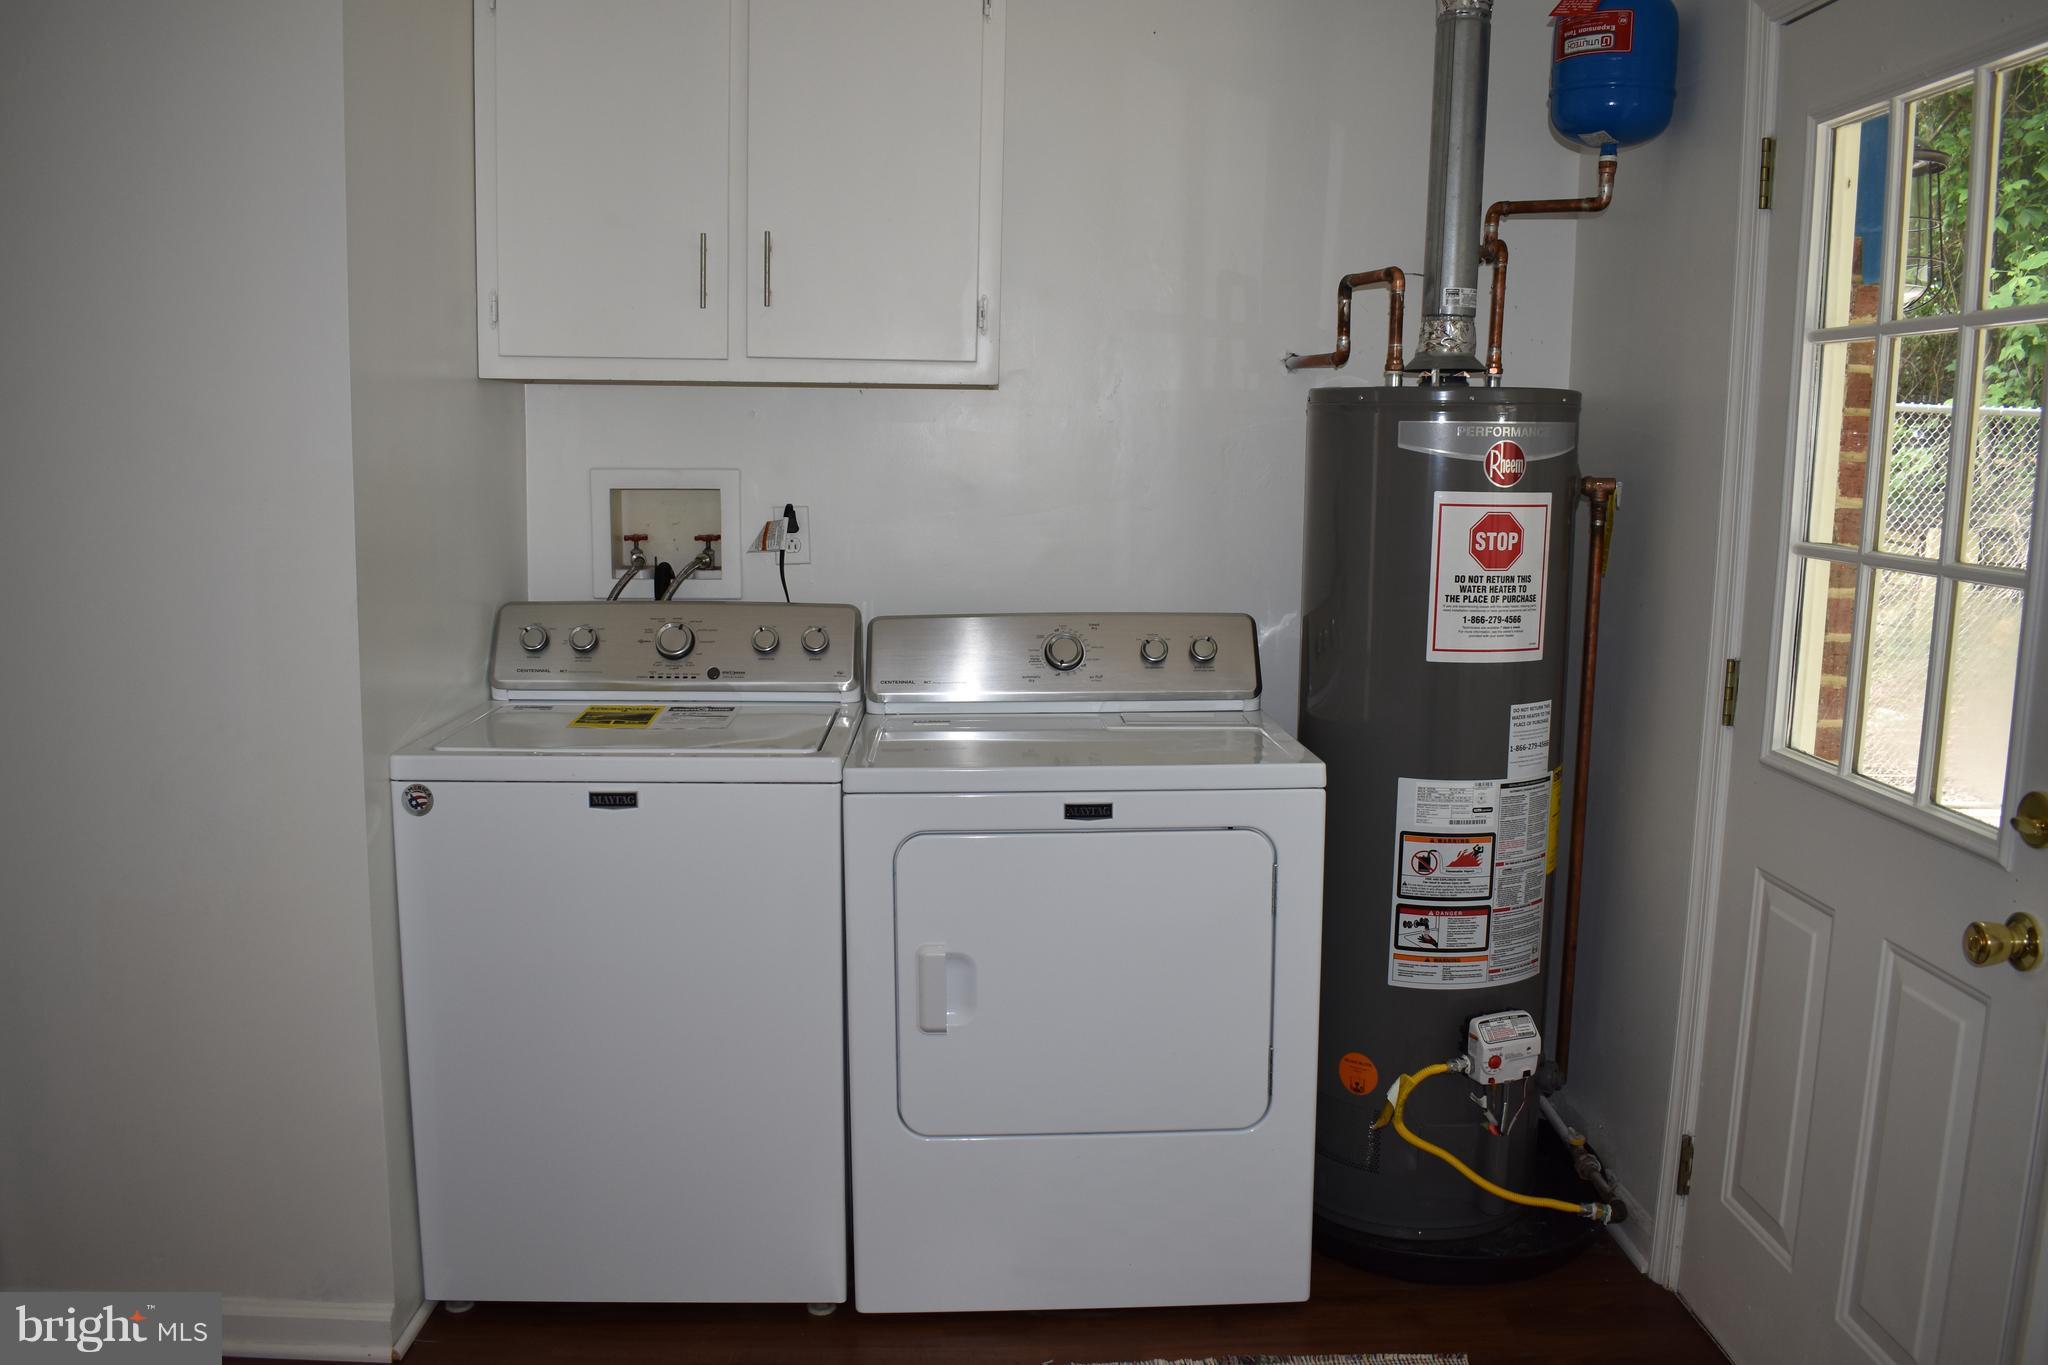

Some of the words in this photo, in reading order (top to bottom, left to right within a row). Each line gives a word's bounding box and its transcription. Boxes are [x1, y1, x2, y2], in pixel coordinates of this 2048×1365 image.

[1578, 24, 1616, 33] Expansion
[1490, 442, 1524, 480] Rheem
[1475, 531, 1519, 551] STOP
[1454, 575, 1466, 584] DO
[1468, 575, 1484, 584] NOT
[1486, 575, 1515, 583] RETURN
[1517, 575, 1532, 583] THIS
[1459, 585, 1487, 593] WATER
[1489, 585, 1516, 593] HEATER
[1519, 585, 1527, 593] TO
[1445, 594, 1460, 603] THE
[1462, 595, 1488, 603] PLACE
[1490, 595, 1500, 603] OF
[1502, 594, 1537, 603] PURCHASE
[1462, 615, 1522, 624] 1-866-279-4566
[591, 795, 635, 805] MAYTAG
